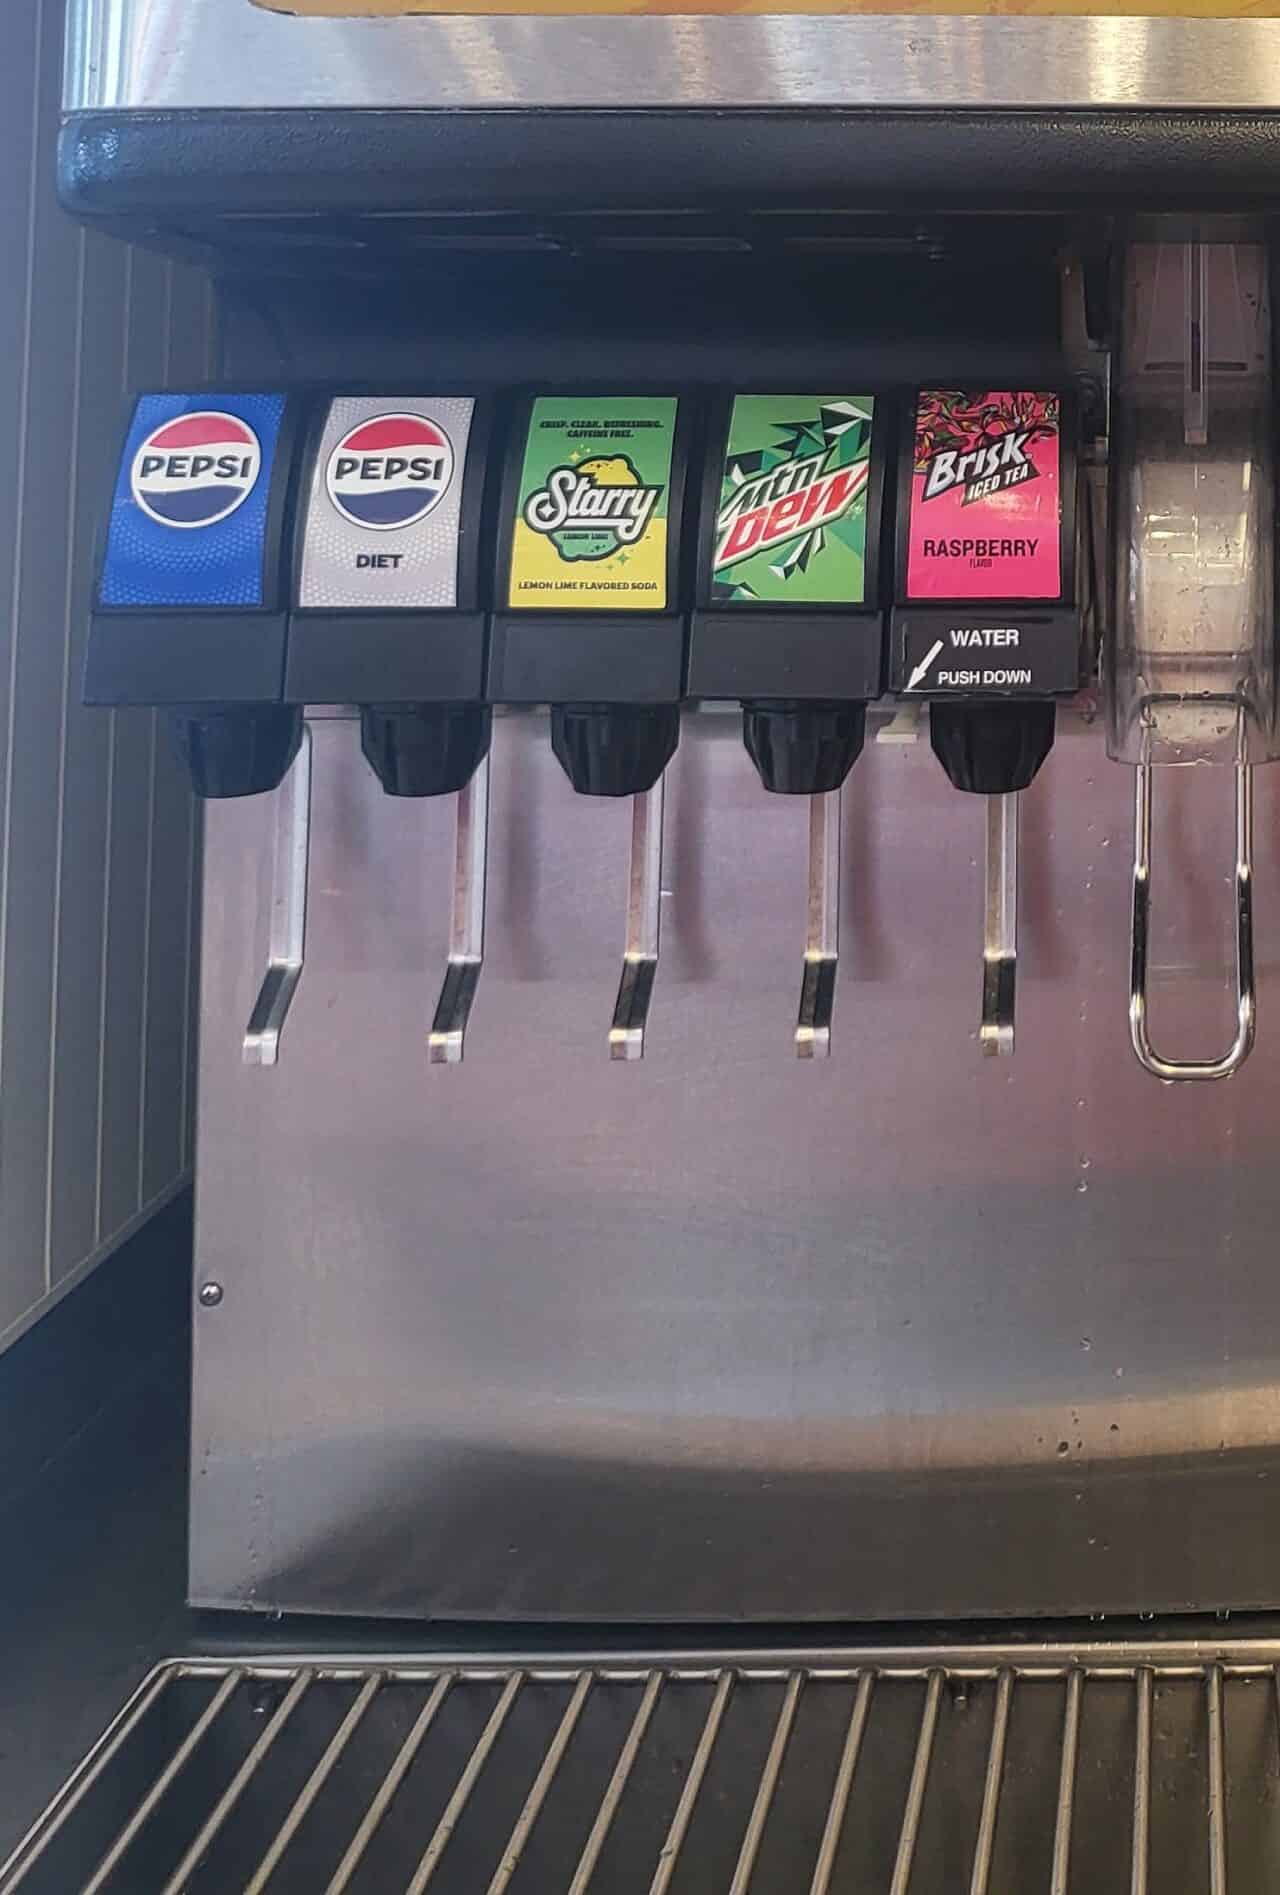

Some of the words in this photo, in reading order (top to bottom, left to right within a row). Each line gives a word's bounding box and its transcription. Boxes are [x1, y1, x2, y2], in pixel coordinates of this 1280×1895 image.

[140, 454, 253, 479] PEPSI
[335, 456, 445, 482] PEPSI
[967, 474, 1001, 501] ICED
[1004, 462, 1029, 485] TEA
[719, 460, 818, 527] Mtn
[527, 469, 658, 541] Starry
[923, 539, 1039, 557] RASPBERRY
[356, 554, 404, 569] DIET
[518, 581, 553, 591] LEMON
[554, 581, 578, 591] LIME
[579, 581, 630, 591] FLAVORED
[631, 582, 658, 591] SODA
[949, 628, 1020, 647] WATER
[937, 671, 980, 685] PUSH
[983, 670, 1032, 684] DOWN
